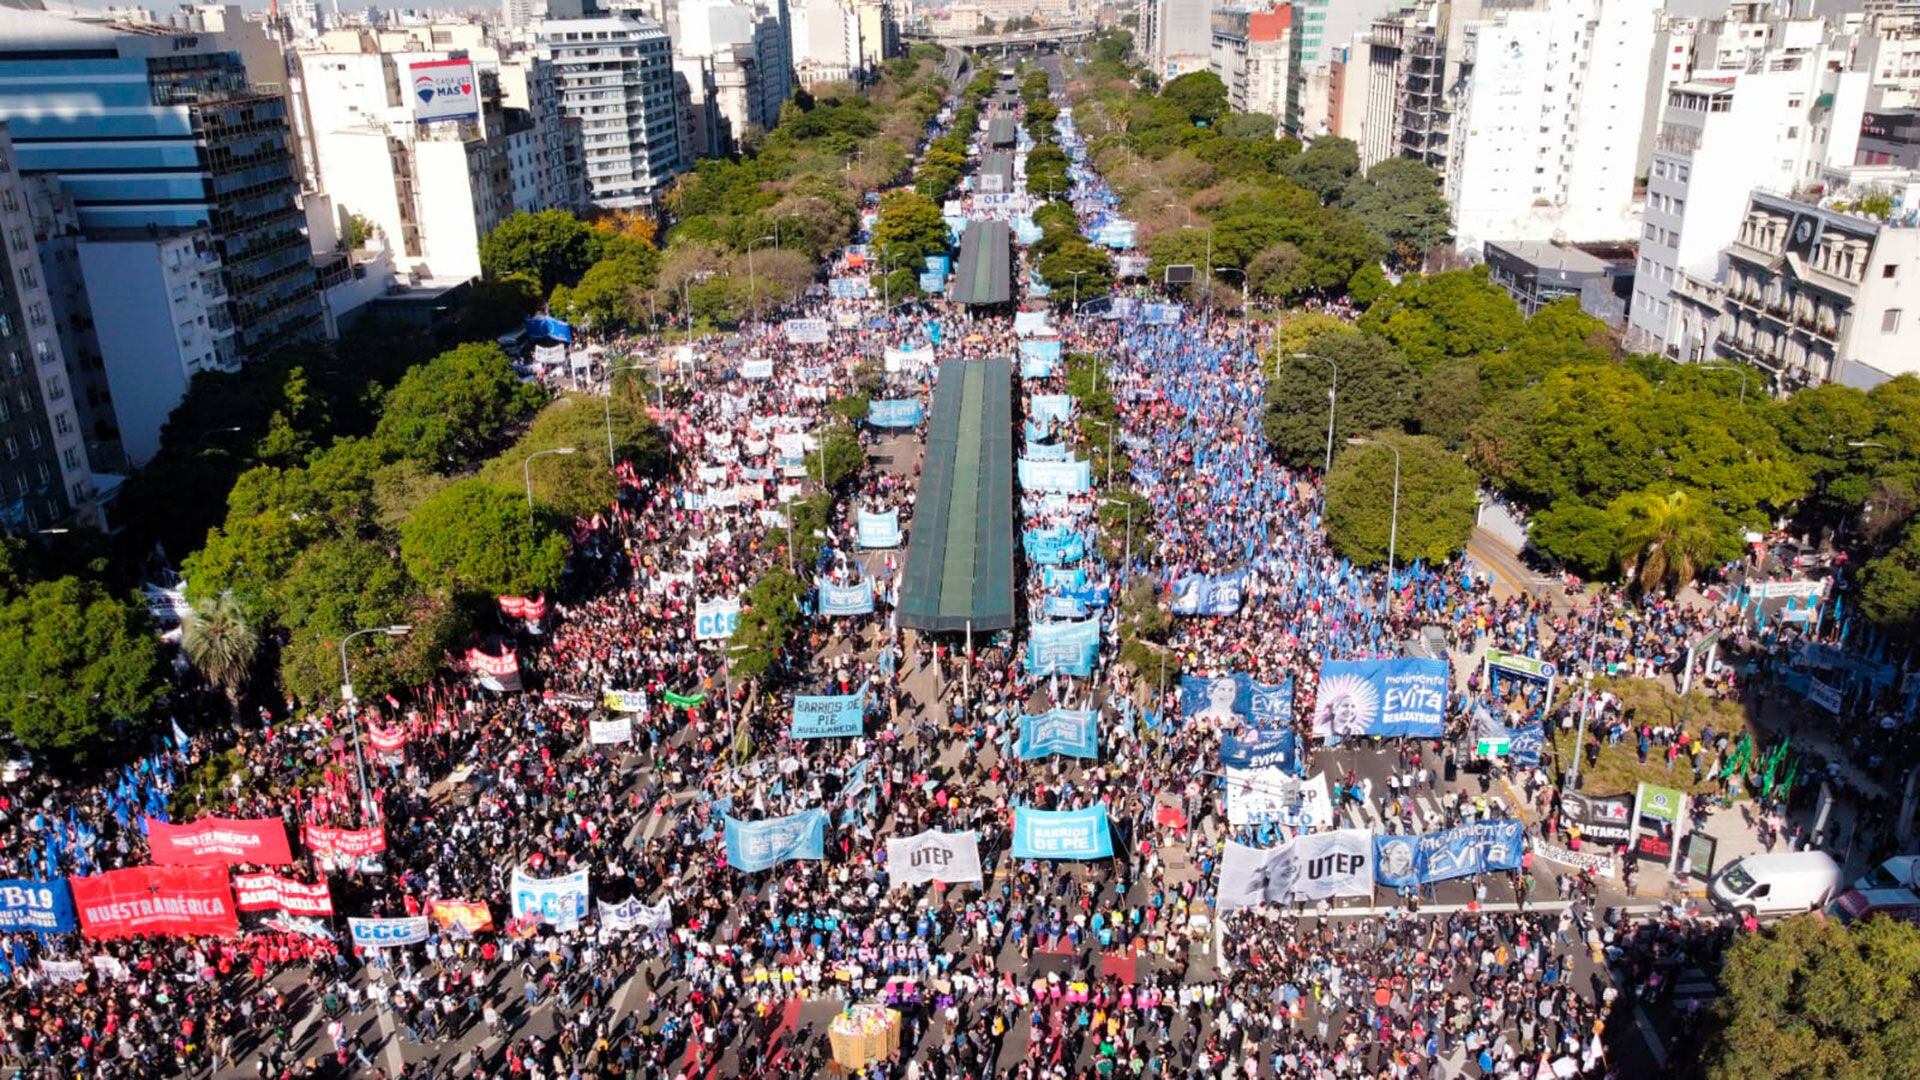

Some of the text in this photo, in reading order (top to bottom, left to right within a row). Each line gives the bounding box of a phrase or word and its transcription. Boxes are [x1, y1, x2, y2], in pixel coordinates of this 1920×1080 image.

[798, 699, 860, 714] BARRIOS DE
[818, 714, 838, 725] PIE
[1034, 827, 1089, 838] BARRIOS
[1034, 838, 1089, 850] DE PIE
[910, 848, 954, 867] UTEP
[1308, 852, 1365, 879] UTEP
[86, 894, 226, 923] NUESTRAMÉRICA
[354, 925, 411, 939] CCC
